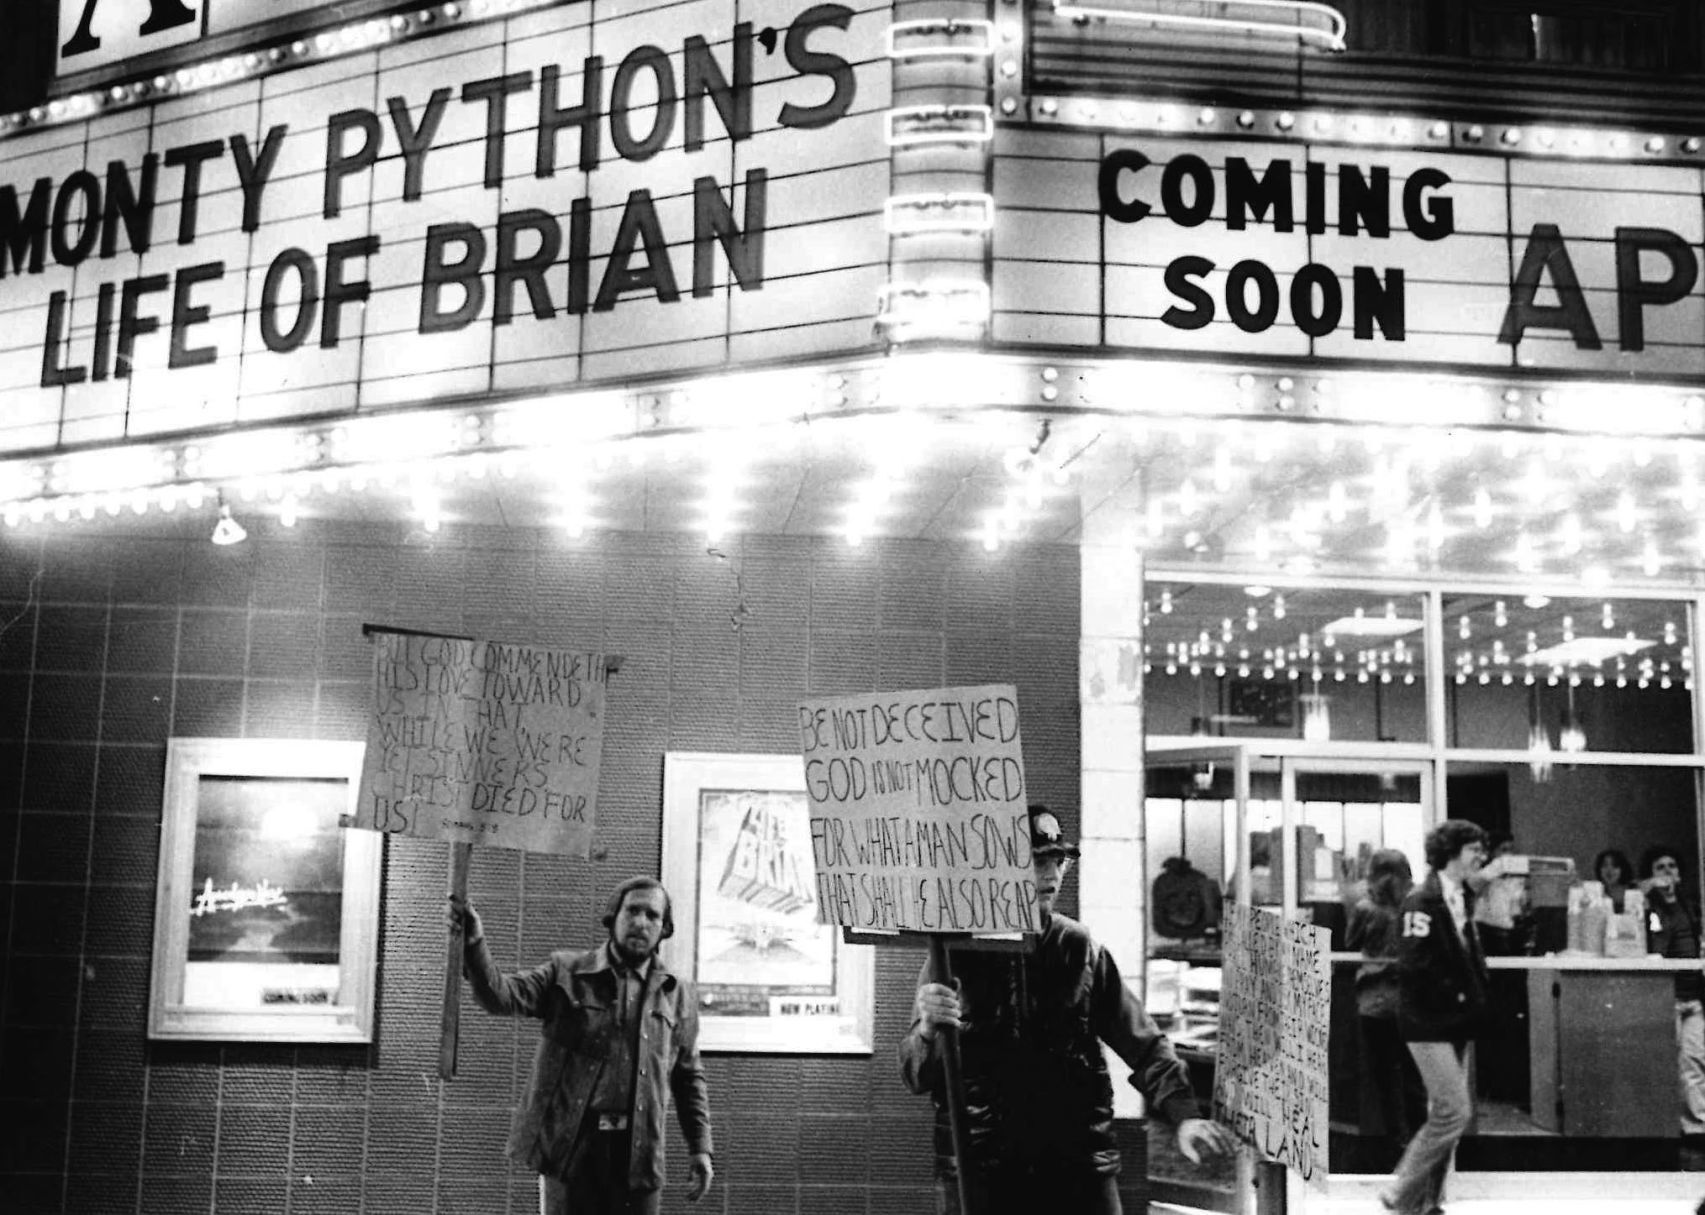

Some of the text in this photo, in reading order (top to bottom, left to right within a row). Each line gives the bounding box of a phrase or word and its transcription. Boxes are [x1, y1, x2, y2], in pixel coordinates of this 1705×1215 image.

[0, 4, 858, 279] MONTY PYTHON'S
[1097, 148, 1455, 241] COMING
[41, 167, 767, 388] LIFE OF BRIAN
[1160, 255, 1406, 341] SOON
[1497, 223, 1699, 351] AP
[420, 638, 465, 667] GOD
[469, 641, 606, 683] COMMENDETH
[478, 667, 582, 708] TOWARD
[376, 713, 588, 766] WHILE WE WERE
[799, 697, 1019, 752] BE NOT DECEIVED
[471, 782, 537, 816] DIED
[543, 789, 588, 823] FOR
[805, 756, 1022, 806] GOD IS NOT MOCKED
[809, 817, 851, 869] FOR
[849, 817, 902, 867] WHAT
[917, 819, 969, 869] MAN
[971, 814, 1032, 870] SOWS
[816, 872, 859, 928] THAT
[937, 877, 985, 930] ALSO
[988, 878, 1037, 932] REAP
